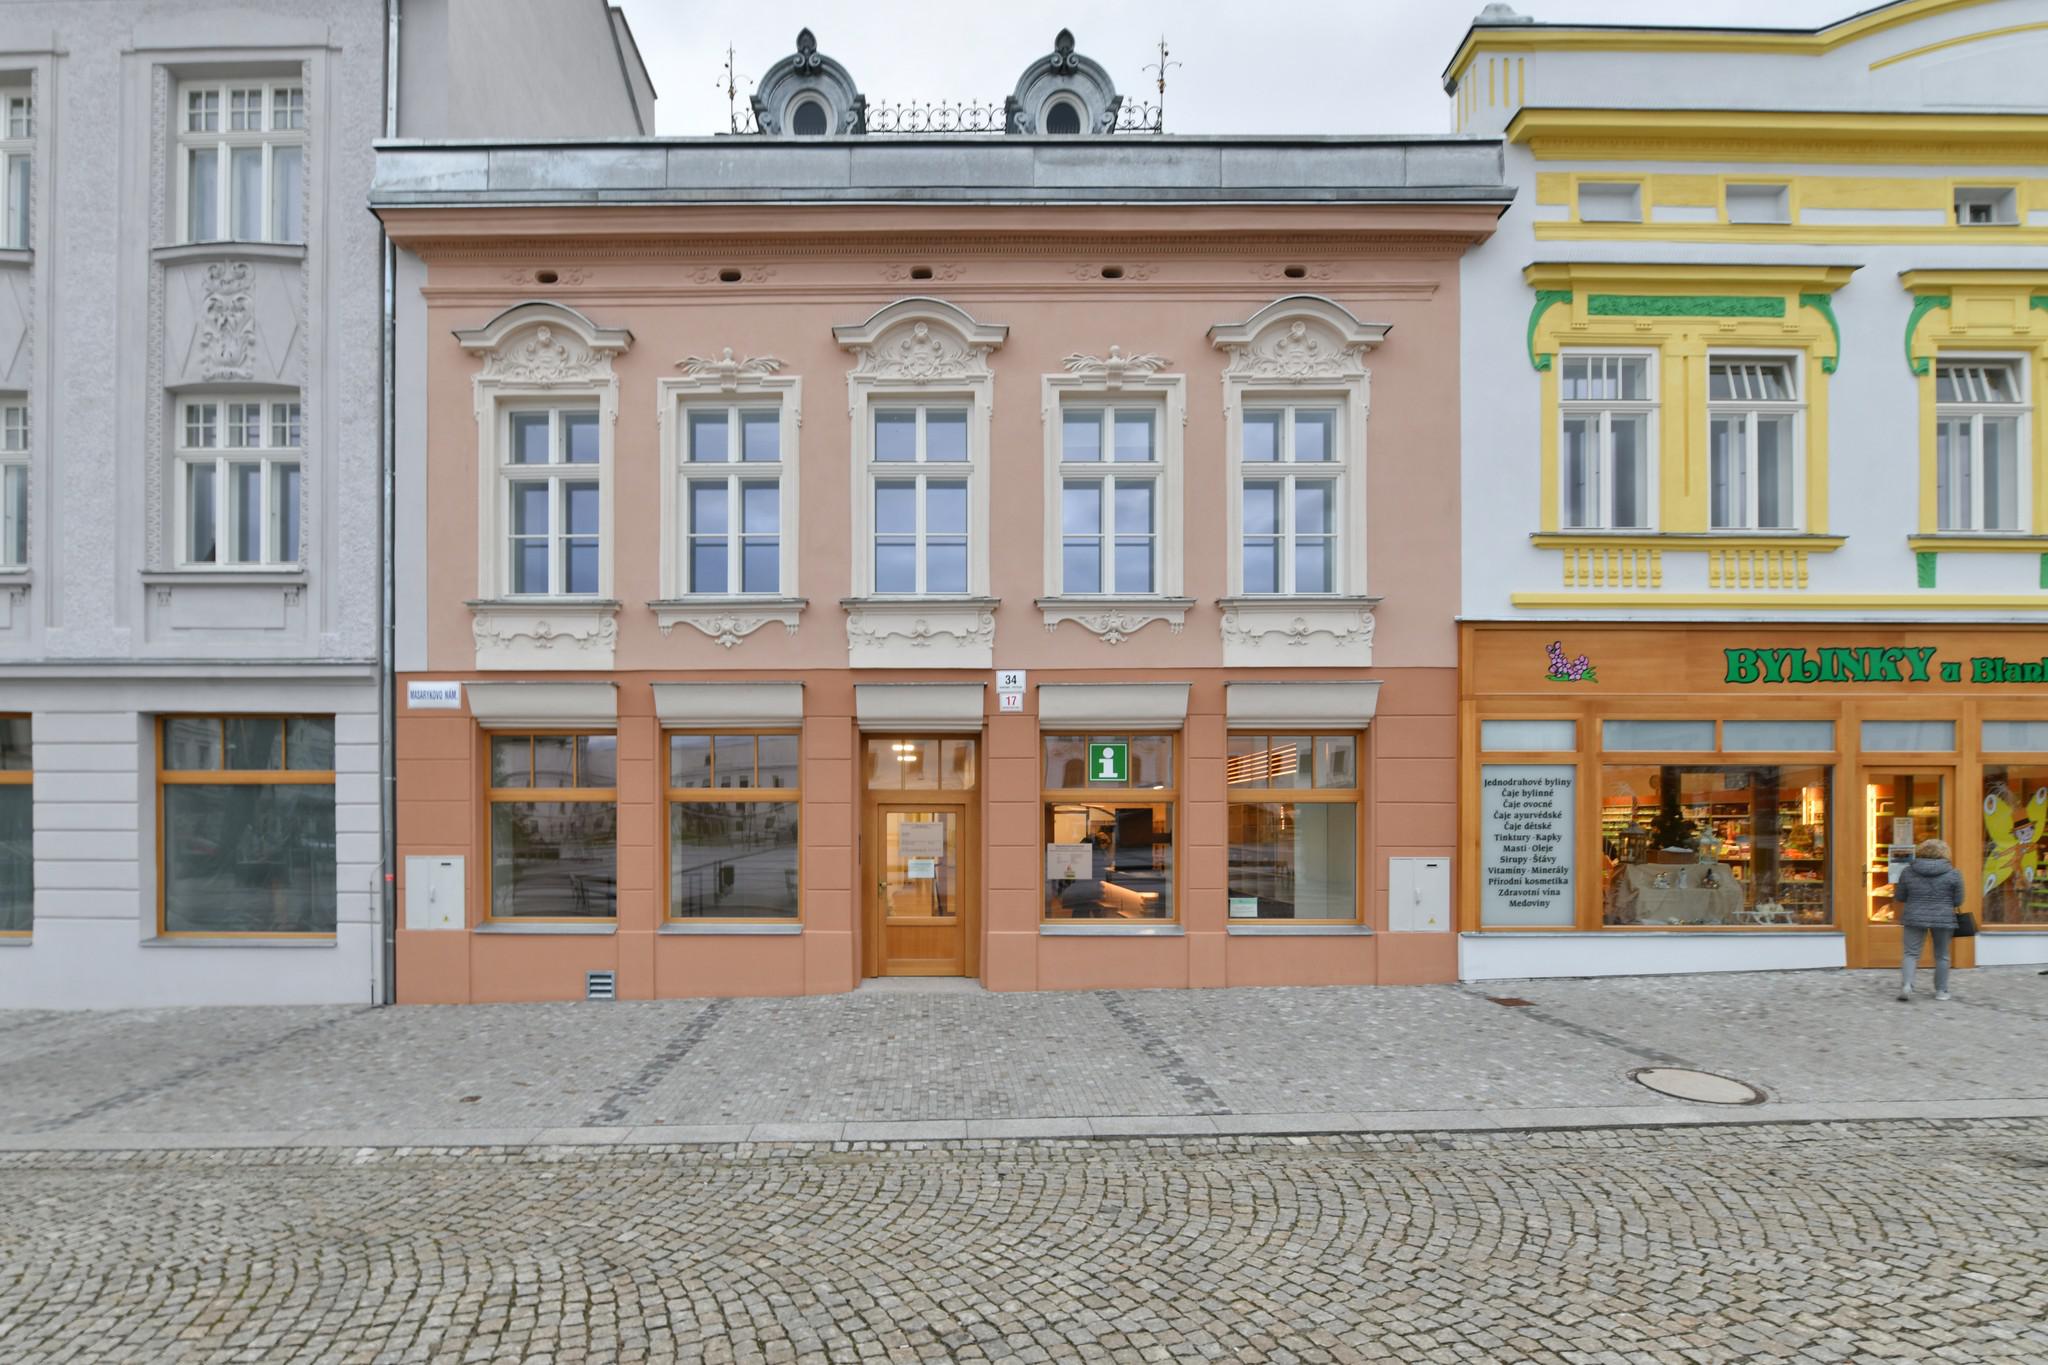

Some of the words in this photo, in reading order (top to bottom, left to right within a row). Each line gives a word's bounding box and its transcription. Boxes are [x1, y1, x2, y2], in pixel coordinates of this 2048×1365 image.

[1724, 647, 1936, 683] BYLINKY
[1941, 662, 1960, 682] u
[1005, 674, 1016, 684] 34
[410, 689, 443, 700] MASARYKOVO
[1006, 696, 1016, 706] 17
[1484, 778, 1542, 787] Jednodruhové
[1545, 778, 1571, 788] byliny
[1502, 788, 1519, 798] Čaje
[1522, 789, 1553, 798] bylinné
[1503, 799, 1520, 809] Čaje
[1494, 811, 1511, 820] Čaje
[1514, 811, 1562, 820] ayurvédské
[1504, 822, 1521, 831] Čaje
[1524, 822, 1551, 830] dětské
[1495, 834, 1530, 842] Tinktury
[1536, 834, 1561, 842] Kapky
[1532, 845, 1553, 853] Oleje
[1500, 856, 1527, 864] Sirupy
[1488, 866, 1525, 875] Vitamíny
[1532, 865, 1568, 875] Minerály
[1509, 900, 1550, 908] Medoviny
